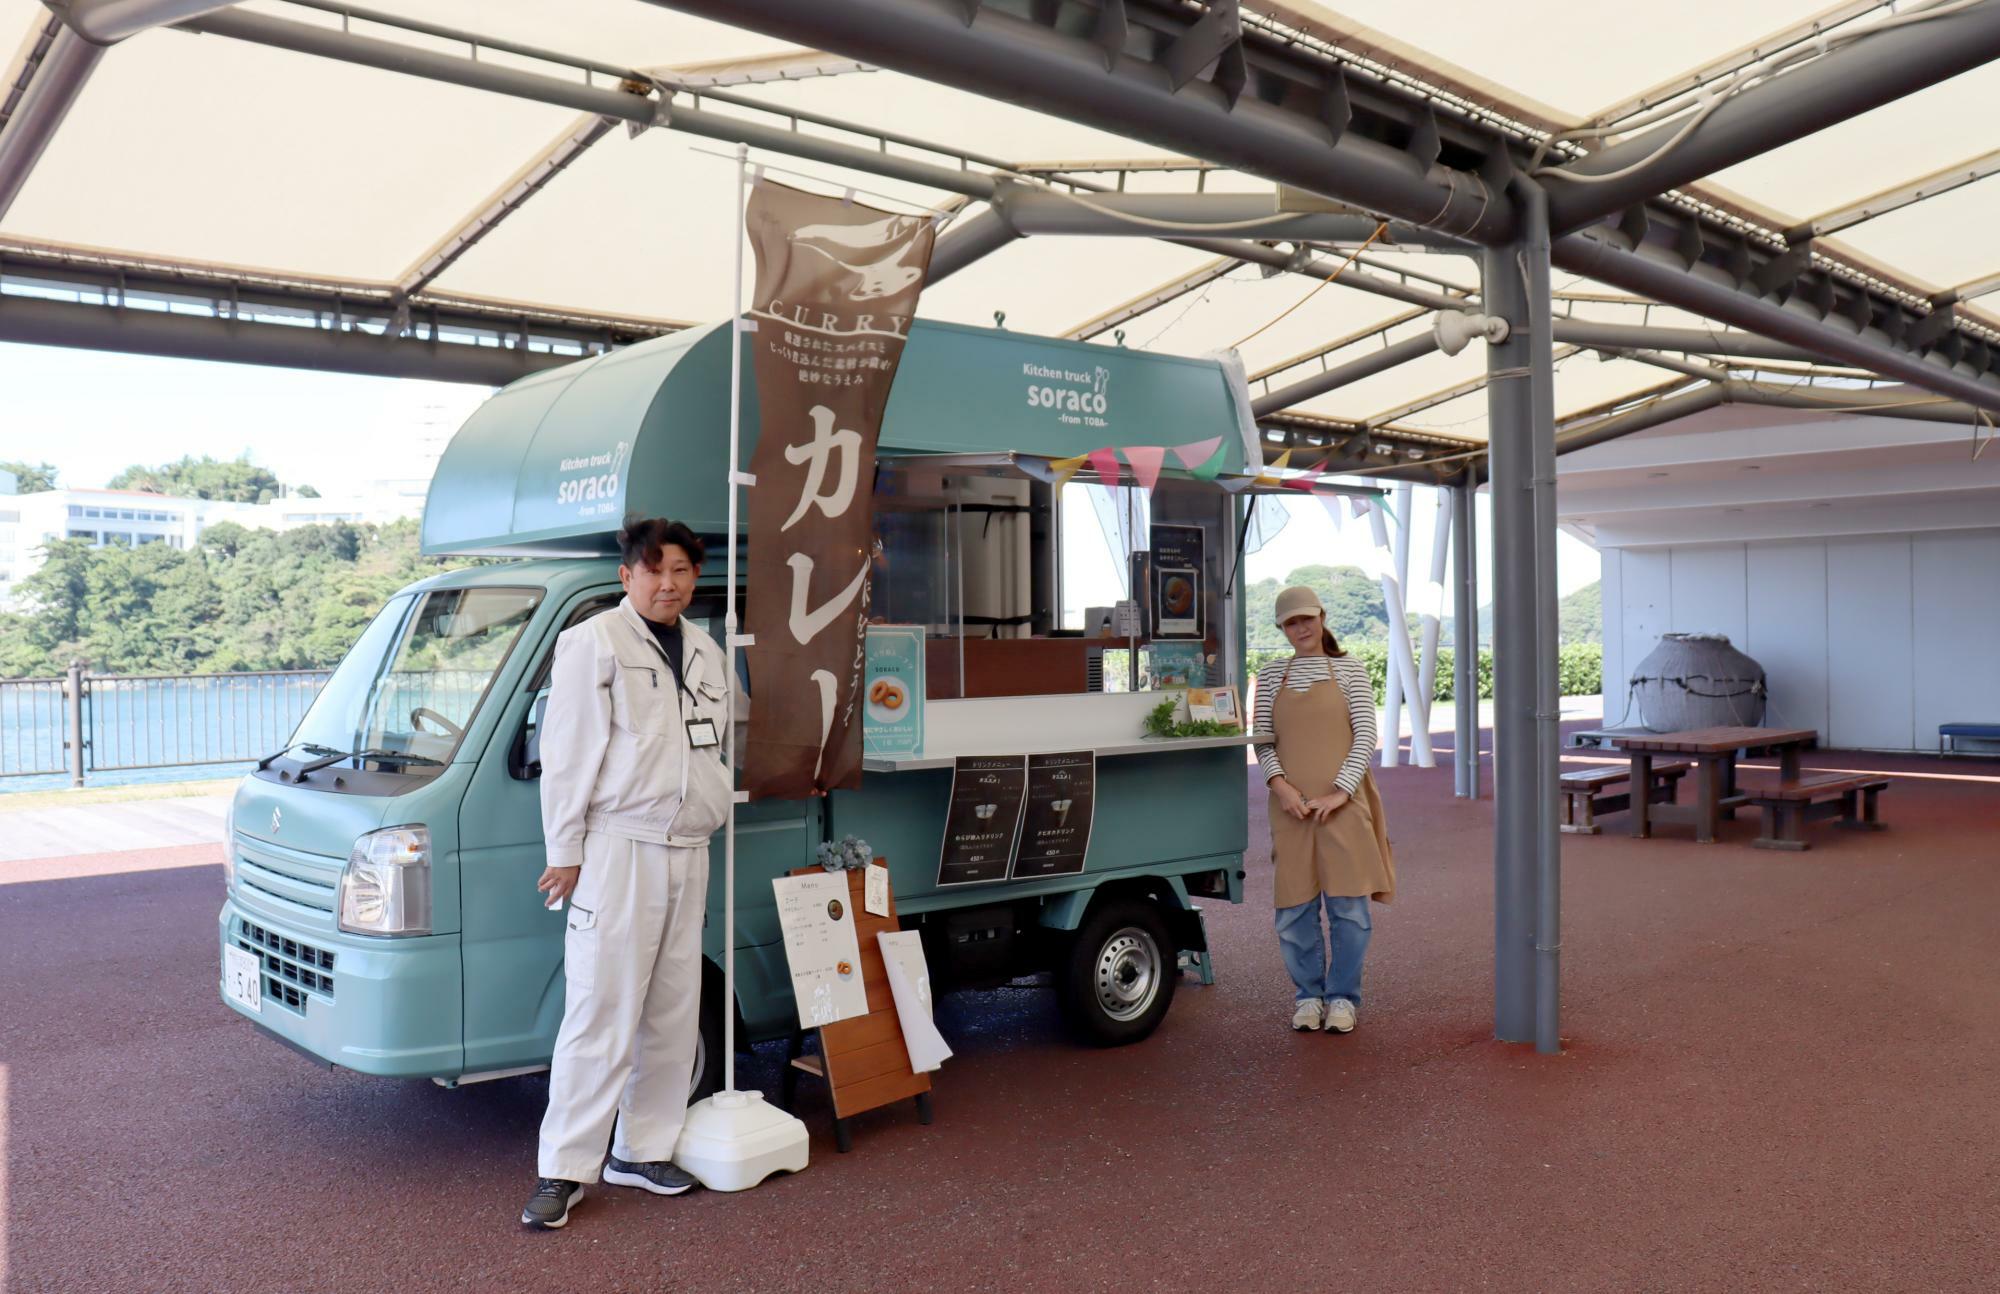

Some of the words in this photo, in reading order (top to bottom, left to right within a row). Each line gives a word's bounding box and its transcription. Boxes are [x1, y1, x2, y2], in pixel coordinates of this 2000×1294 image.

[768, 299, 907, 334] CURRY
[798, 369, 864, 386] 絶妙なうまみ
[1023, 363, 1062, 379] Kitchen
[1064, 370, 1091, 383] truck
[1027, 385, 1107, 414] soraco
[560, 457, 589, 472] Kitchen
[590, 452, 611, 467] truck
[558, 474, 618, 504] soraco
[781, 404, 869, 780] カレー
